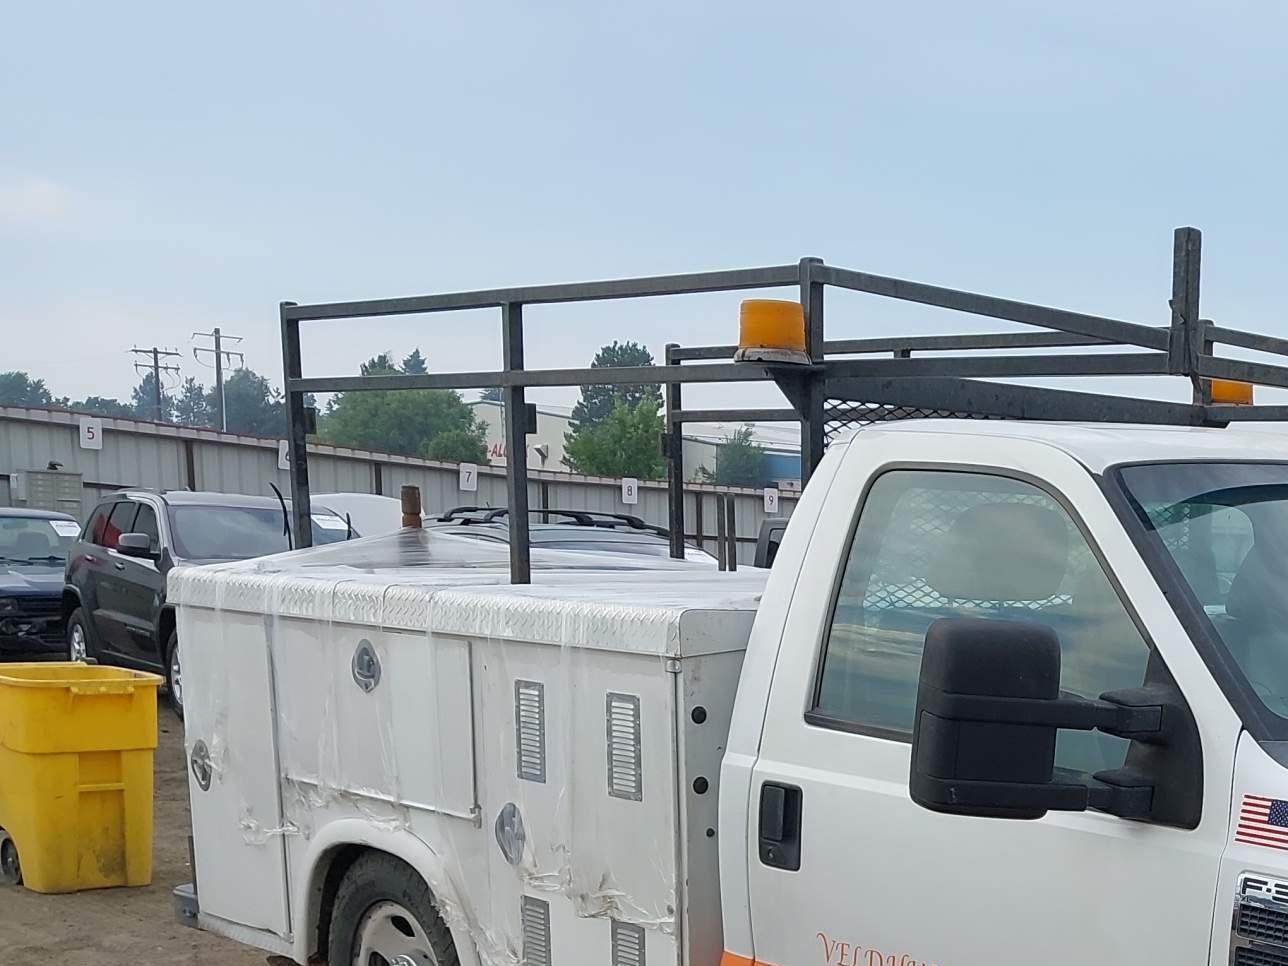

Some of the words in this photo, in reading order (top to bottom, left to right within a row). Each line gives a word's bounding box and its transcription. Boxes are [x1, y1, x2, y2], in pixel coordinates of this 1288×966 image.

[87, 426, 95, 440] 5
[465, 471, 472, 484] 7
[627, 485, 633, 497] 8
[768, 495, 774, 505] 9
